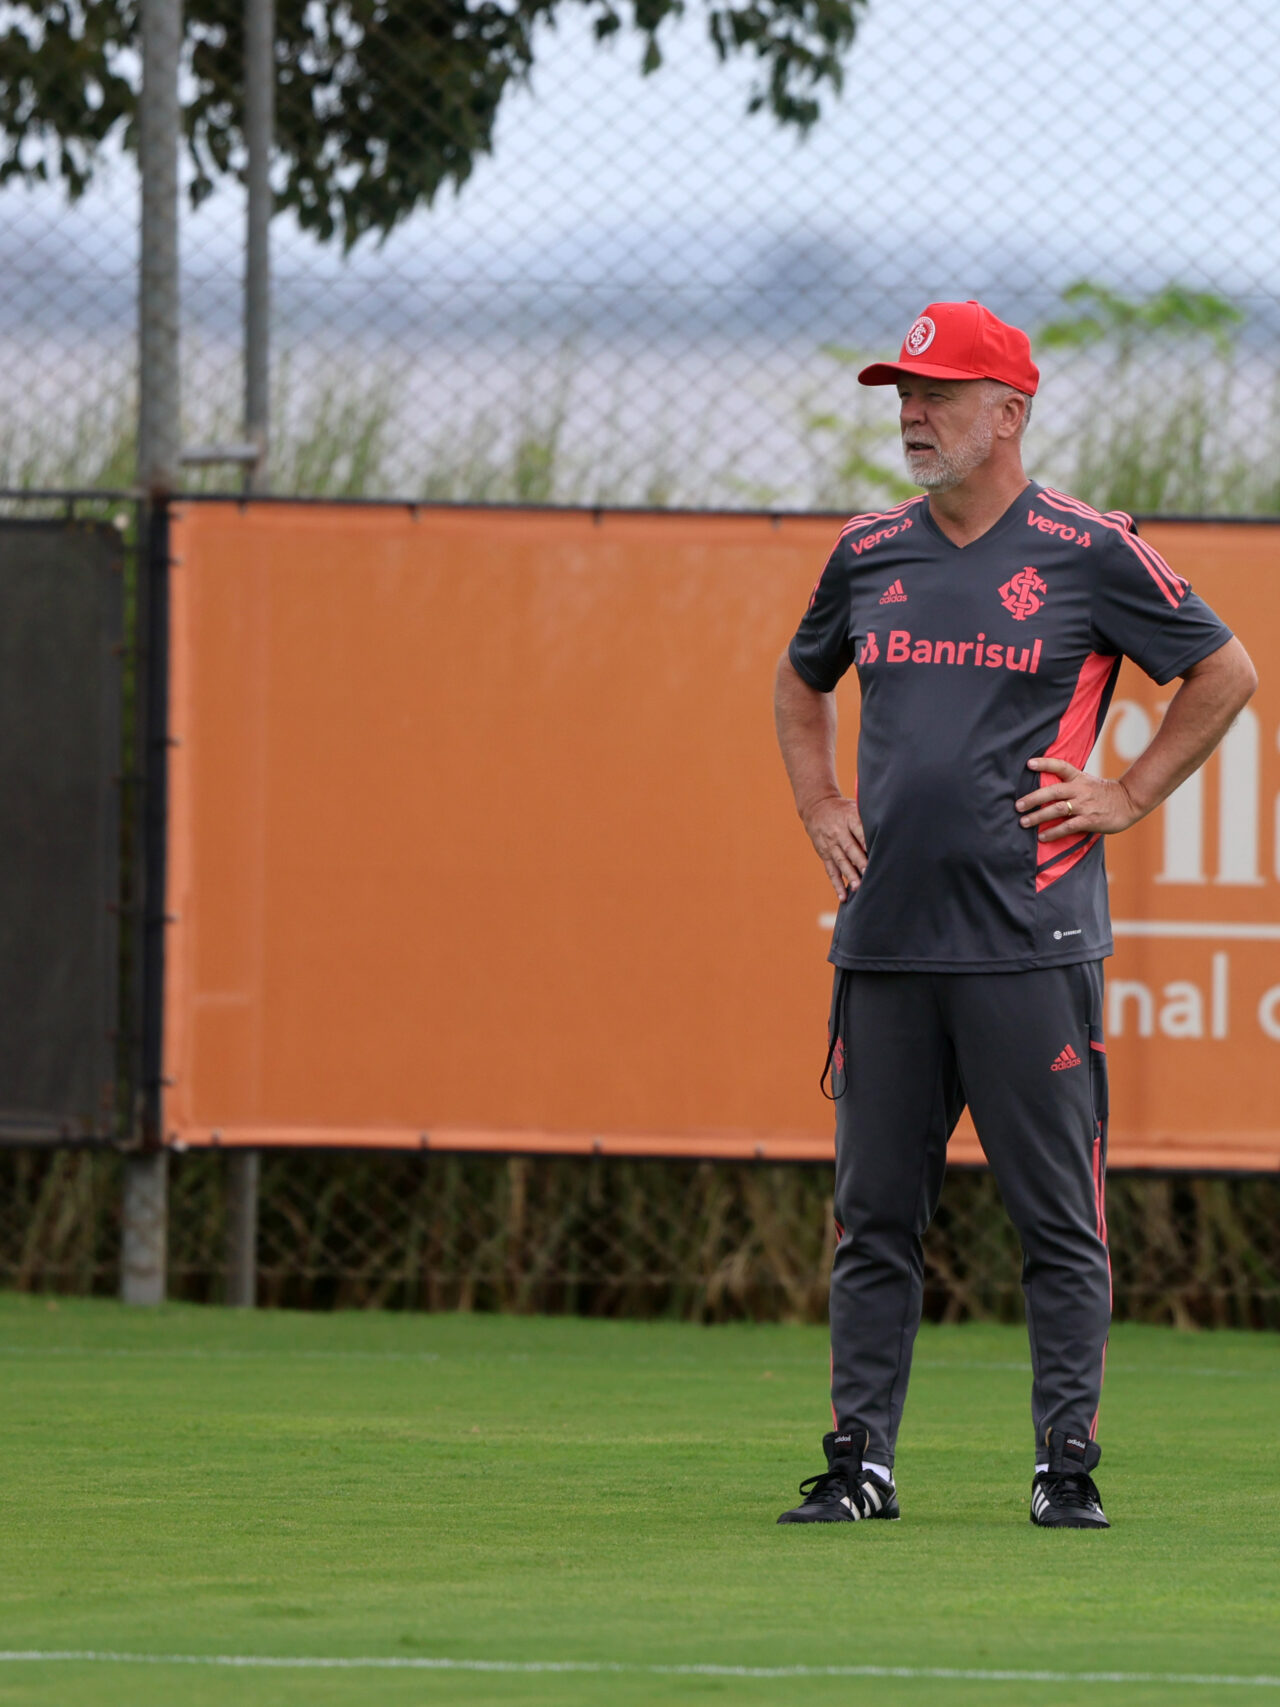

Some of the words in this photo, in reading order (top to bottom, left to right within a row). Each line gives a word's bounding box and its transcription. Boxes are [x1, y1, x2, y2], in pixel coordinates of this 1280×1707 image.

[851, 525, 899, 555] vero
[1027, 509, 1077, 541] vero
[879, 594, 908, 605] adidas
[886, 630, 1043, 674] Banrisul
[1107, 952, 1228, 1040] nal
[1050, 1057, 1082, 1071] adidas
